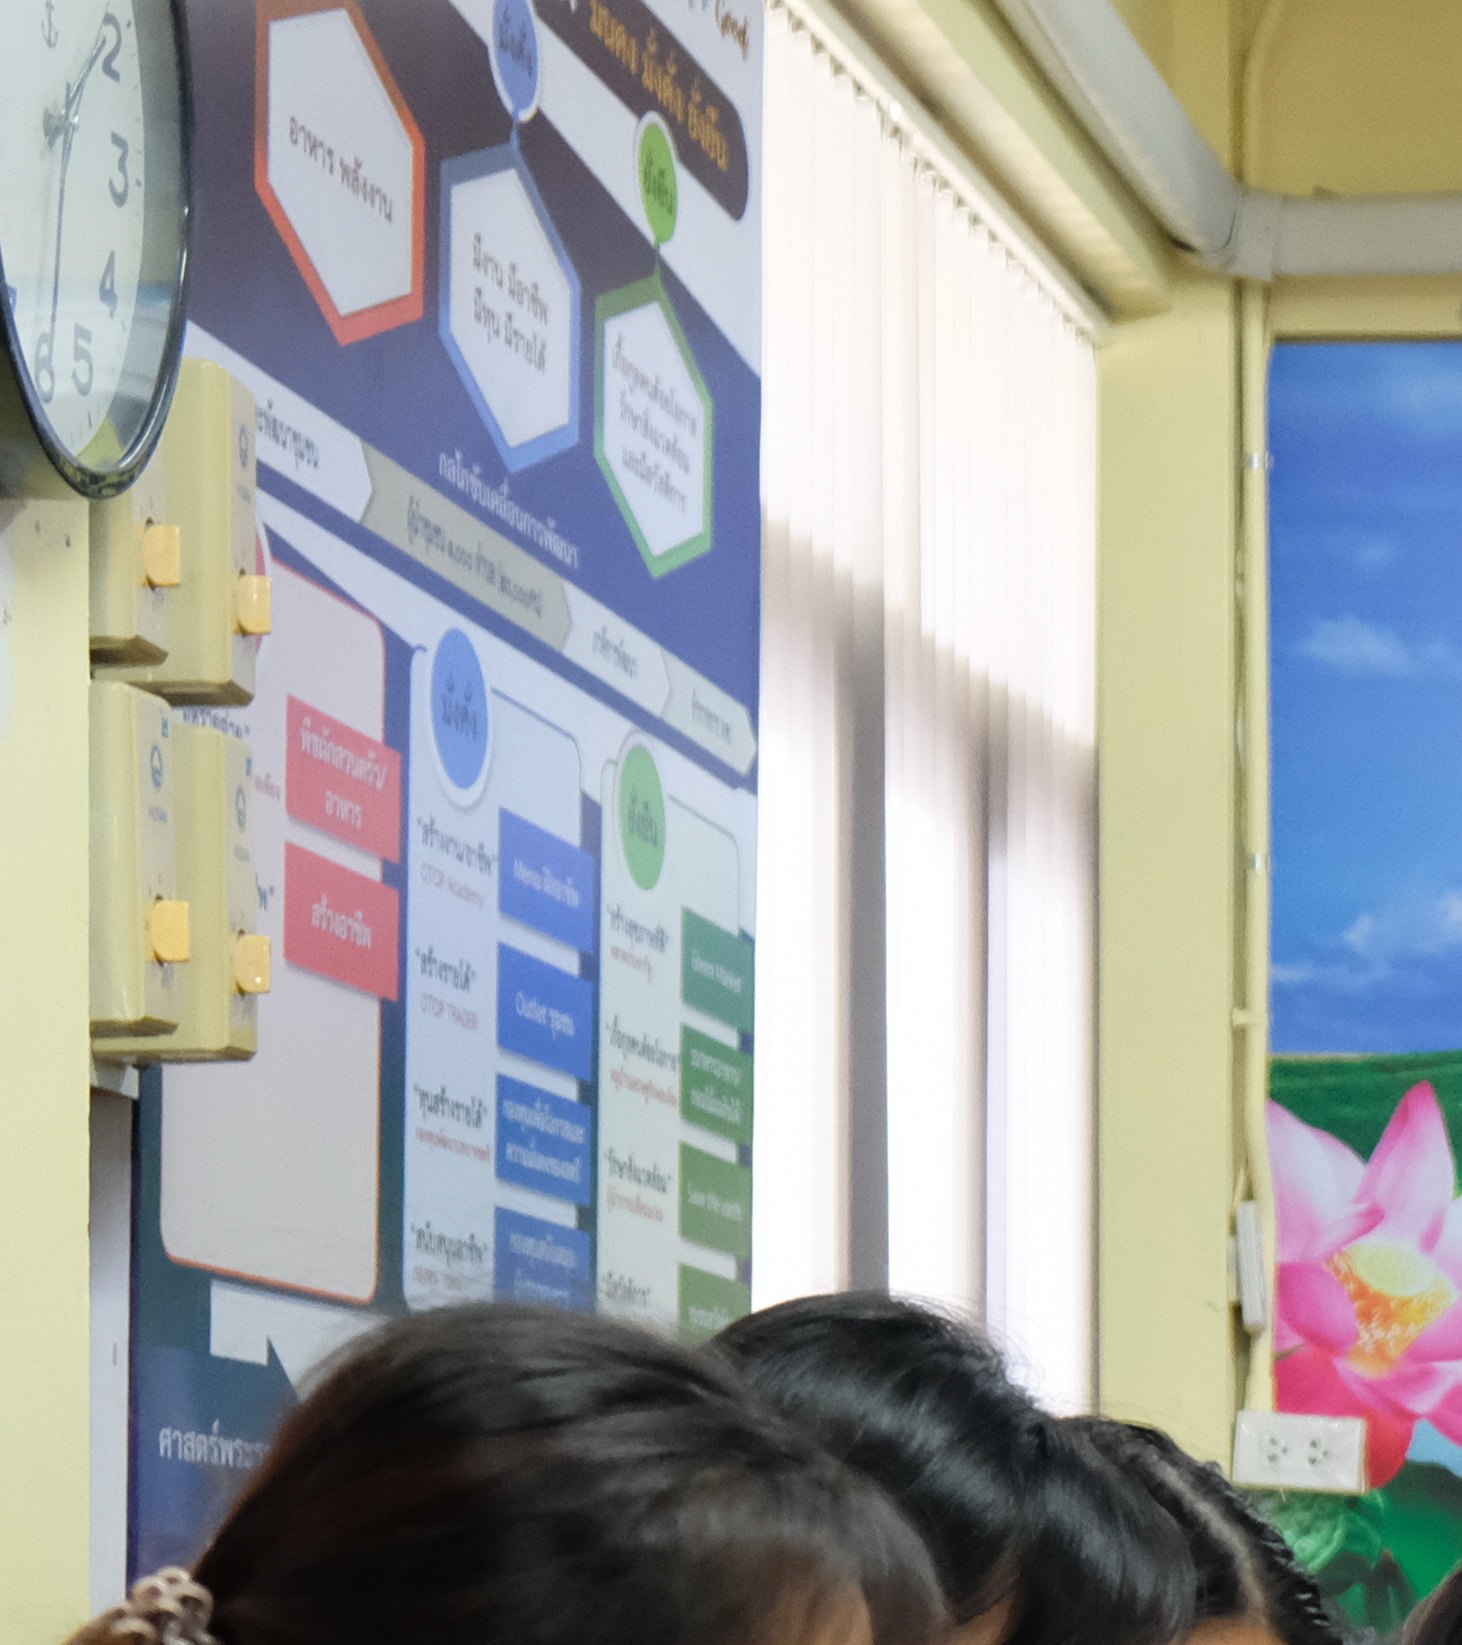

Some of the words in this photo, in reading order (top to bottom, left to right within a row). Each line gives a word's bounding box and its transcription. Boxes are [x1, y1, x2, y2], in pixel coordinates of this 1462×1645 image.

[101, 12, 121, 82] 2
[108, 130, 128, 208] 3
[99, 249, 117, 320] 4
[34, 332, 55, 404] 6
[71, 322, 94, 397] 5
